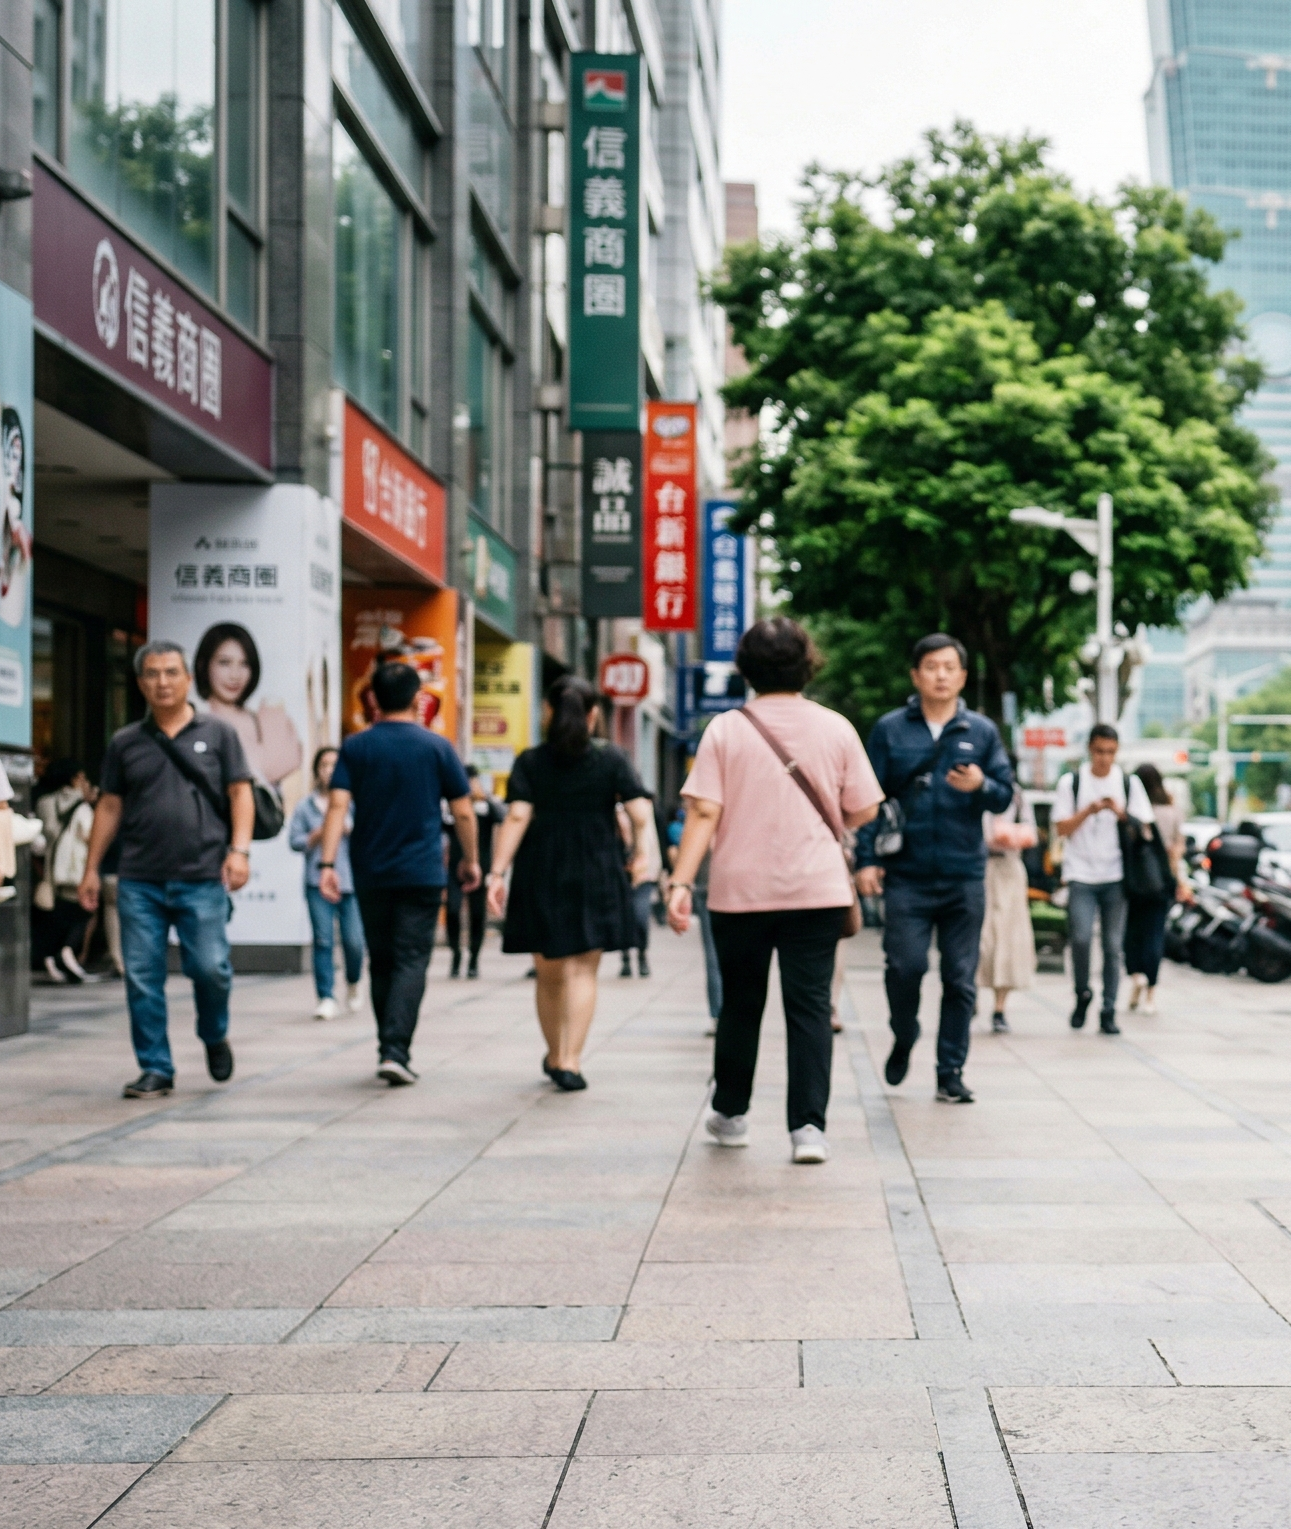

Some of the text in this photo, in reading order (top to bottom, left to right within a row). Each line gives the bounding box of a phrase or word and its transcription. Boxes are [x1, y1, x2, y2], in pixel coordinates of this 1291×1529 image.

[583, 126, 628, 318] 信義商圈
[124, 266, 222, 421] 信義商圈
[592, 457, 632, 533] 誠品
[654, 481, 687, 620] 台新銀行
[174, 563, 279, 589] 信義商圈
